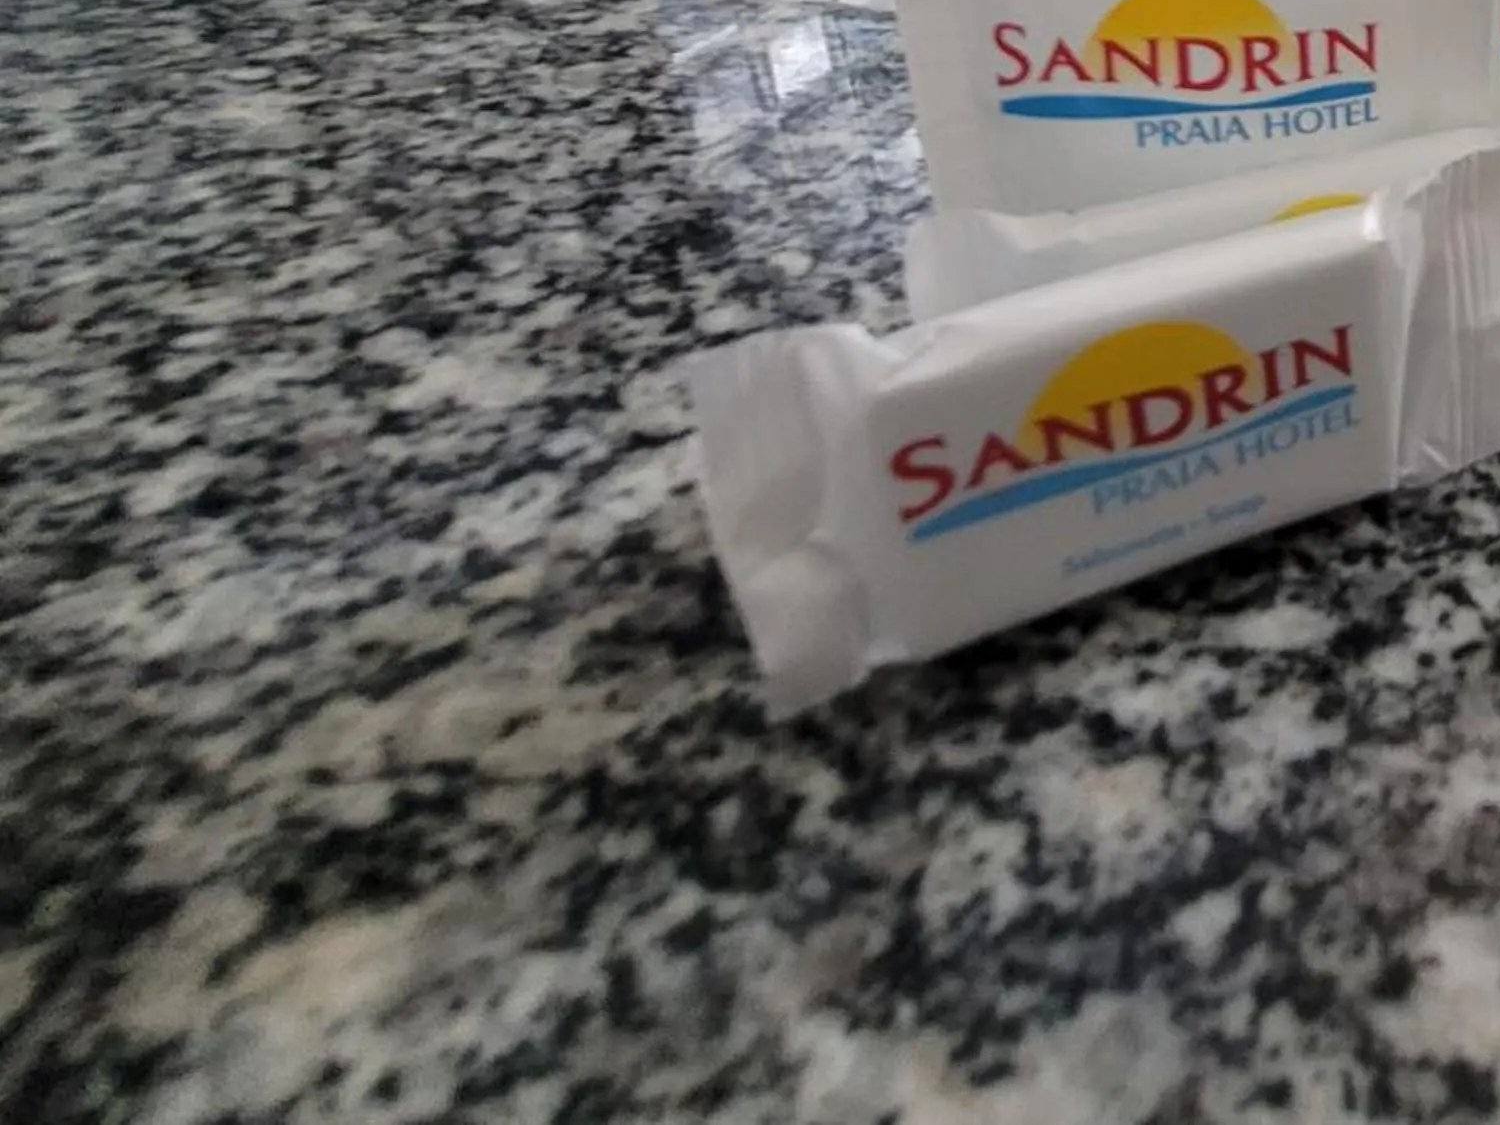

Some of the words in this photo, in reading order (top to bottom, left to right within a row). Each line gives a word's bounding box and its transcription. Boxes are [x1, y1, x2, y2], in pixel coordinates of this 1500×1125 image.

[992, 21, 1380, 94] SANDRIN
[1136, 115, 1250, 148] PRAIA
[1265, 99, 1380, 139] HOTEL
[889, 323, 1354, 524] SANDRIN
[1092, 449, 1221, 515] PRAIA
[1233, 402, 1361, 467] HOTEL
